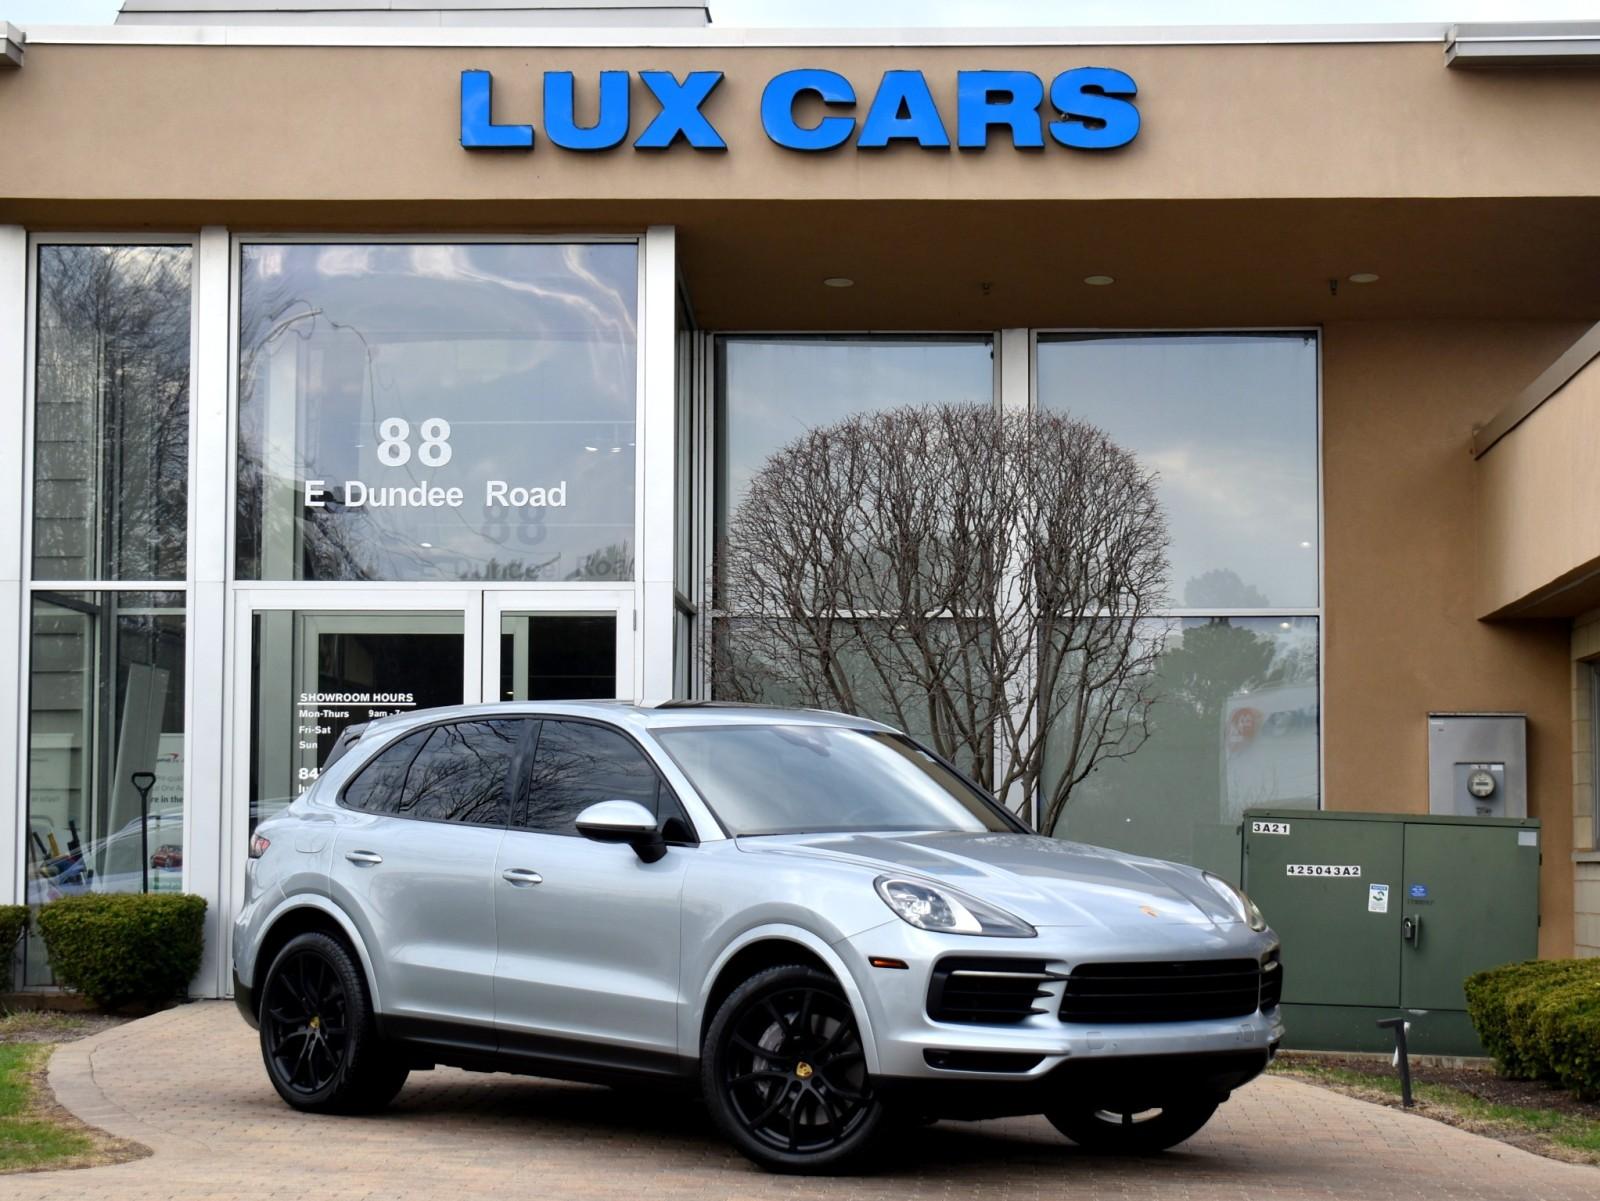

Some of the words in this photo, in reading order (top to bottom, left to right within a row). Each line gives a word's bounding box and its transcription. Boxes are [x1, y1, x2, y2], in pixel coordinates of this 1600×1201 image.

[460, 69, 727, 151] LUX
[760, 67, 1141, 152] CARS
[377, 417, 452, 467] 88
[304, 480, 326, 507] E
[344, 480, 464, 507] Dundee
[485, 480, 567, 507] Road
[300, 693, 370, 702] SHOWROOM
[373, 693, 414, 702] HOURS
[299, 709, 350, 718] Mon-Thurs
[368, 709, 388, 718] 9am
[298, 726, 331, 734] Fri-Sat
[298, 741, 318, 749] Sun
[298, 767, 323, 780] 84
[1254, 823, 1288, 833] 3A21
[1288, 865, 1360, 876] 425043A2
